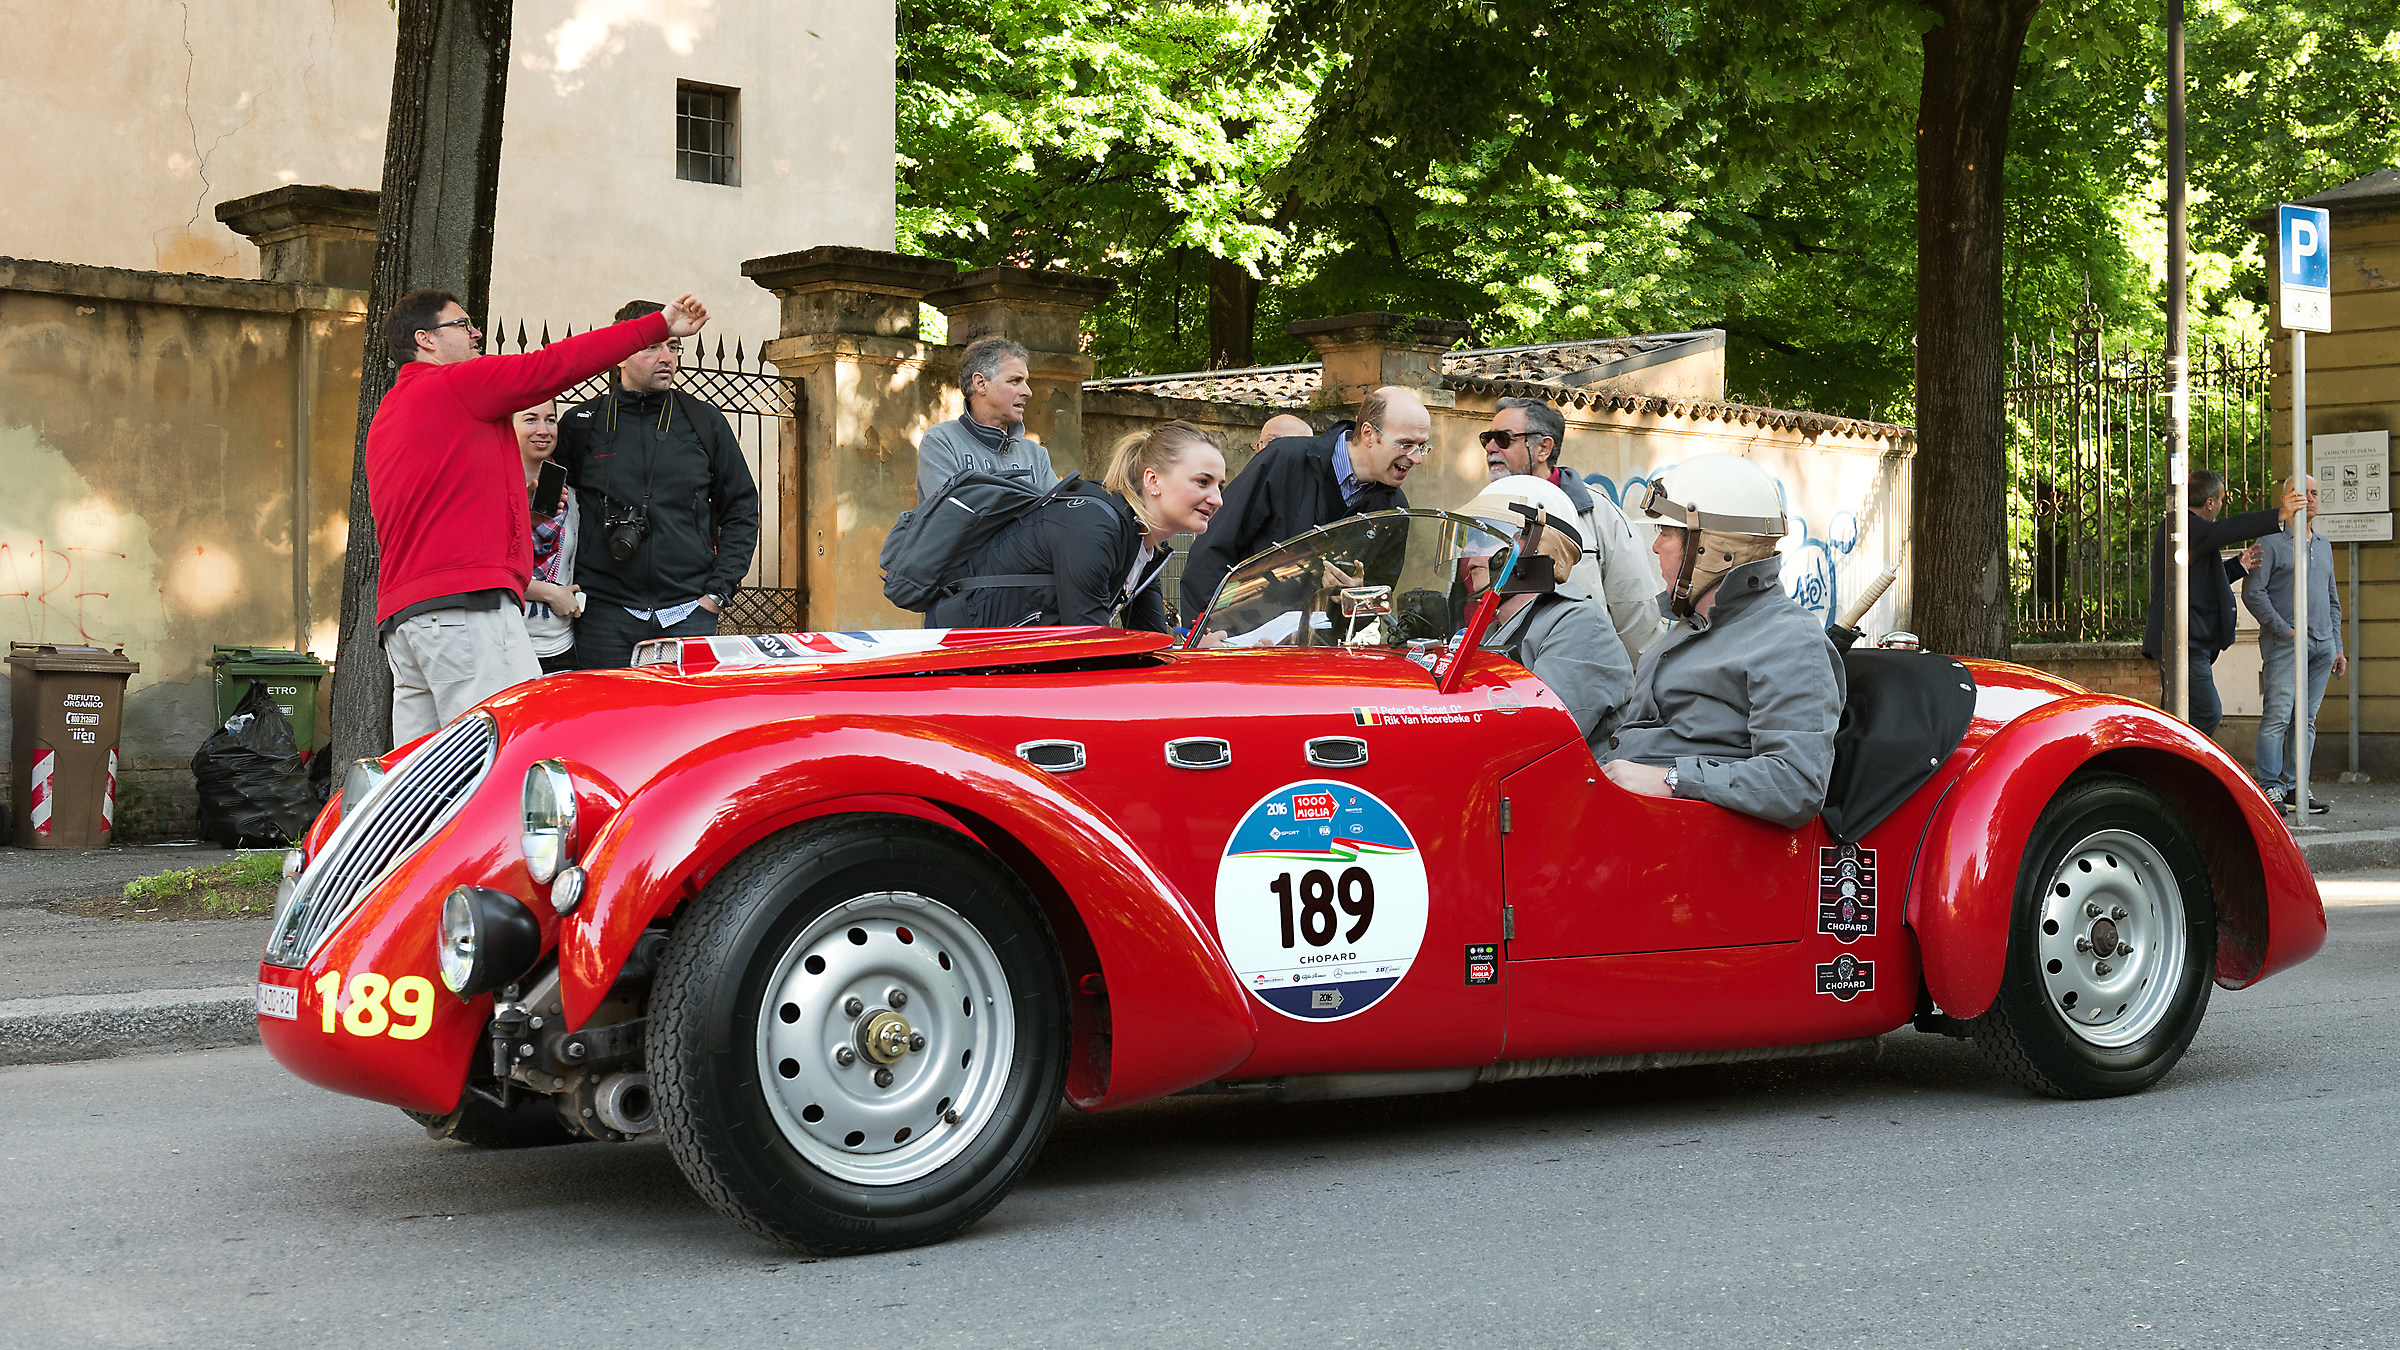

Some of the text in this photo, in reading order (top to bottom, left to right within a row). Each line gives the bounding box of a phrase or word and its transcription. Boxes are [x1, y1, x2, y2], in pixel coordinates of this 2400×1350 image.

[2291, 217, 2318, 275] P
[757, 634, 786, 657] 2014
[267, 686, 297, 695] ETRO
[1380, 706, 1406, 715] Peter
[1407, 705, 1421, 714] De
[1422, 705, 1447, 714] Smet
[1384, 715, 1400, 725] Rik
[1401, 715, 1419, 725] Van
[1420, 714, 1470, 724] Hoorebeke
[73, 731, 95, 740] iren
[1297, 796, 1327, 807] 1000
[1266, 802, 1288, 816] 2016
[1297, 807, 1330, 818] MIGLIA
[1270, 866, 1375, 949] 189
[1827, 923, 1868, 932] CHOPARD
[1299, 952, 1357, 964] CHOPARD
[1825, 980, 1866, 990] CHOPARD
[1319, 993, 1333, 1002] 2016
[314, 970, 435, 1040] 189
